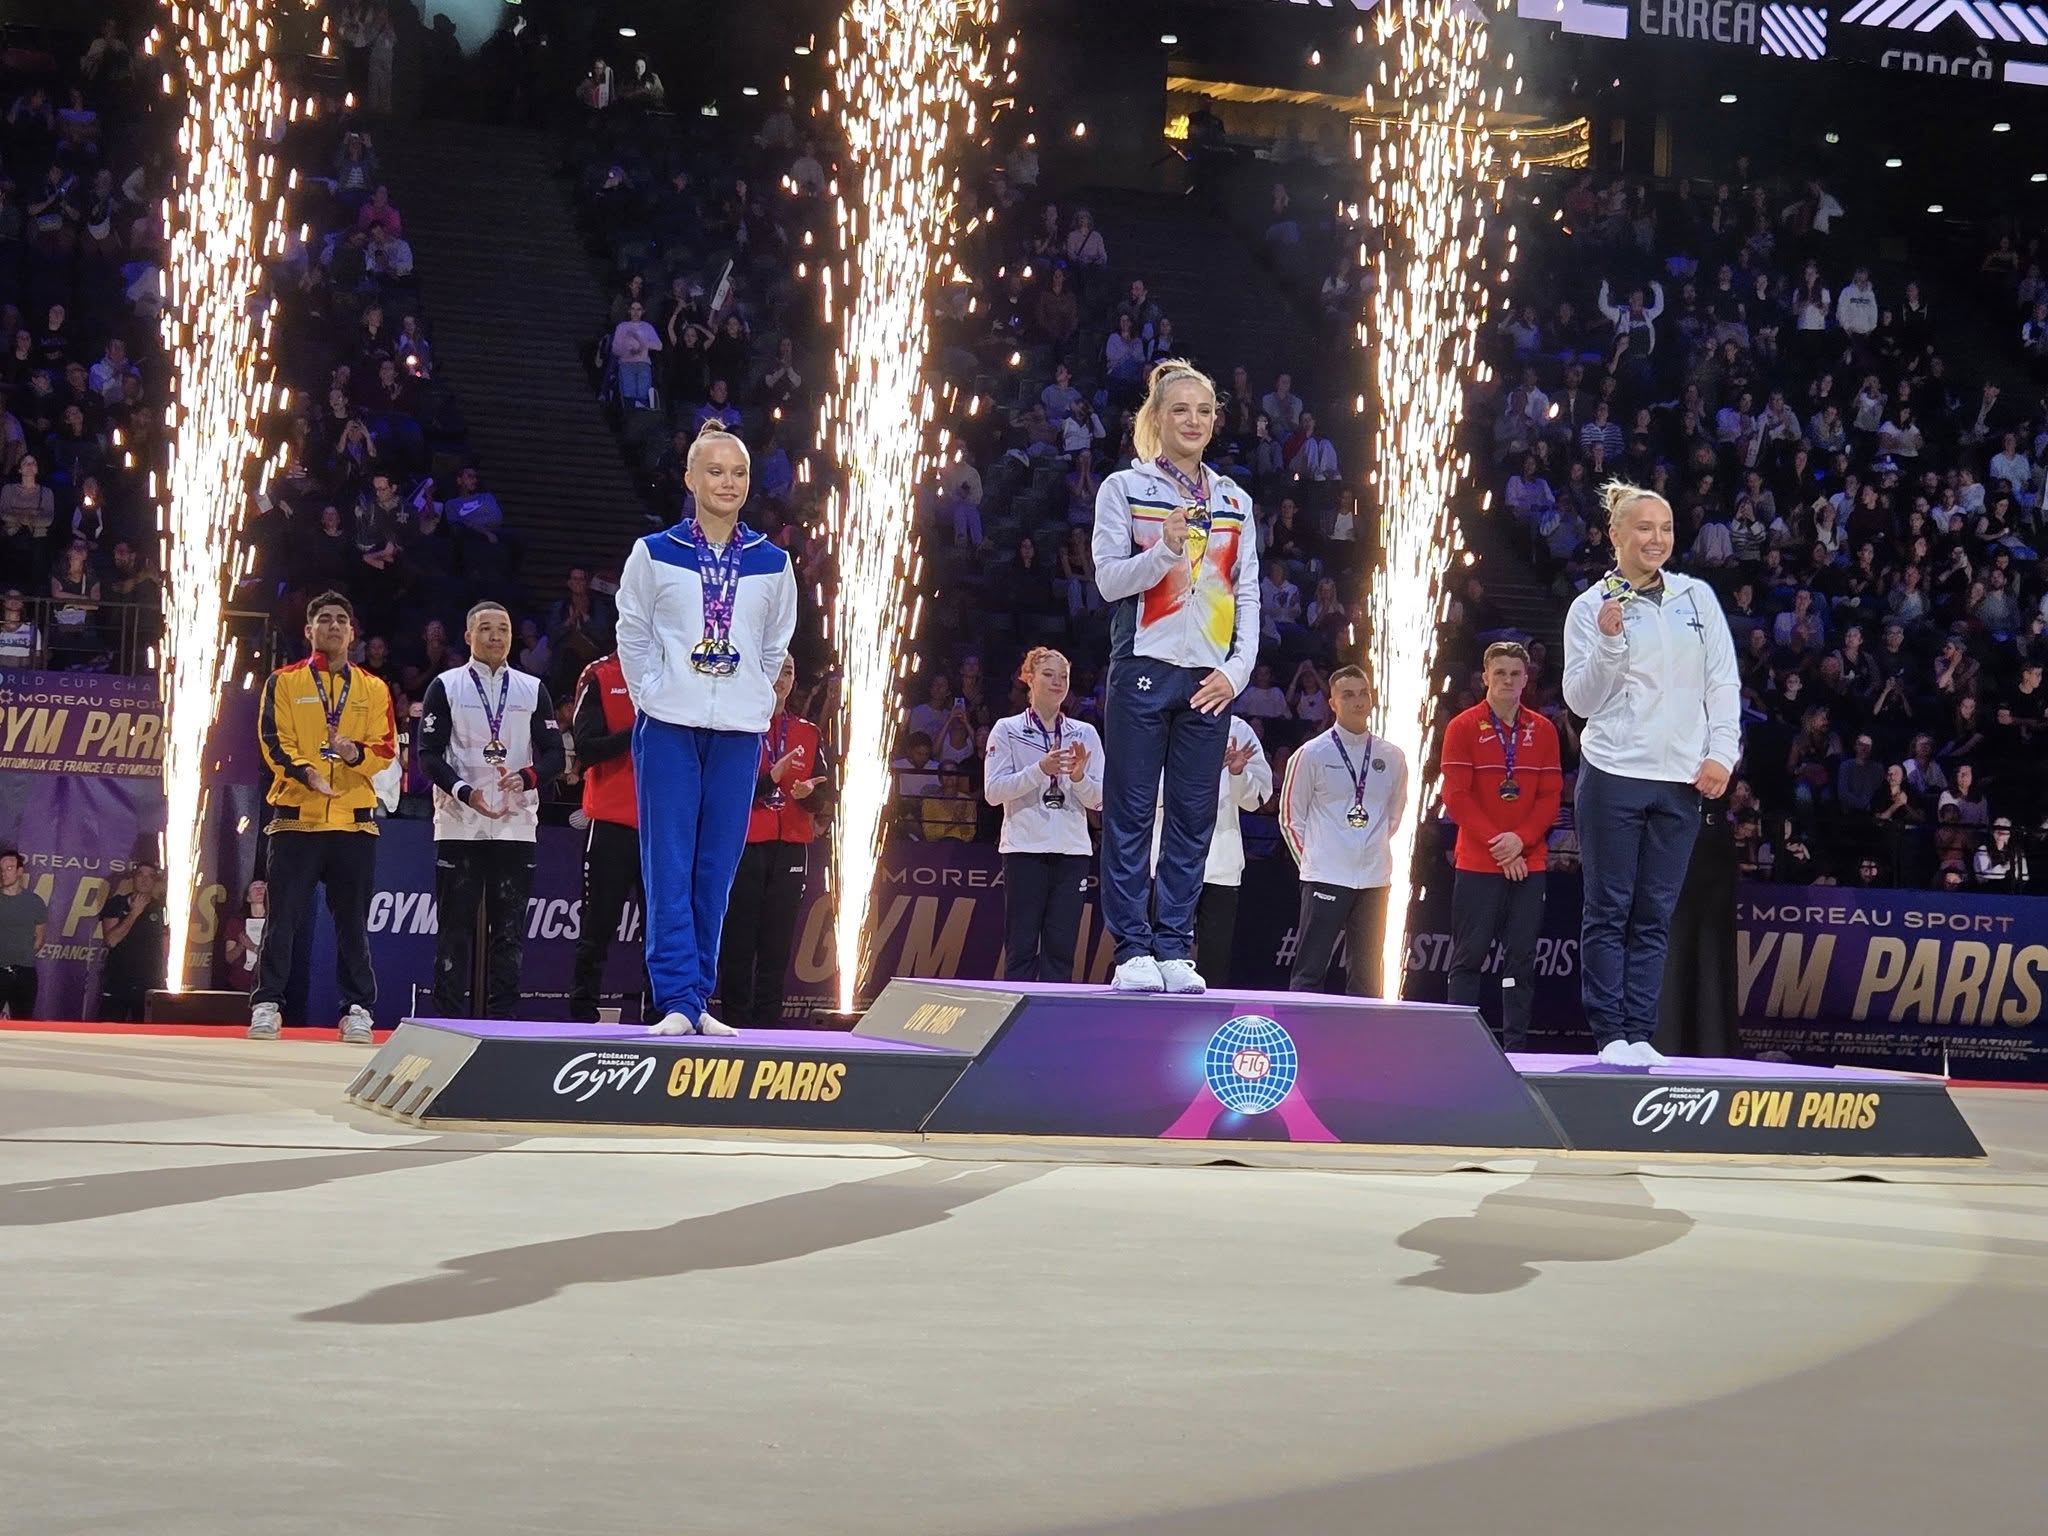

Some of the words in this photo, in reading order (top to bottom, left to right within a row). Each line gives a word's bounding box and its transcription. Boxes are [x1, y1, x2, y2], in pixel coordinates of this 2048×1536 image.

[0, 674, 45, 685] RLD
[60, 678, 98, 688] CUP
[113, 681, 151, 691] CHA
[19, 693, 102, 706] MOREAU
[0, 706, 69, 754] YM
[0, 757, 47, 770] ATIONAUX
[49, 760, 63, 771] DE
[63, 761, 101, 773] FRANCE
[101, 763, 115, 774] DE
[117, 763, 162, 776] GYMNAST
[18, 852, 100, 870] OREAU
[882, 867, 1005, 888] MOREA
[1753, 906, 1892, 927] MOREAU
[1904, 911, 2015, 933] SPORT
[1736, 930, 1837, 1019] YM
[1852, 936, 2048, 1027] PARIS
[1238, 1052, 1268, 1076] FIG
[666, 1057, 745, 1099] GYM
[749, 1060, 847, 1101] PARIS
[1728, 1091, 1794, 1128] GYM
[1798, 1092, 1880, 1130] PARIS
